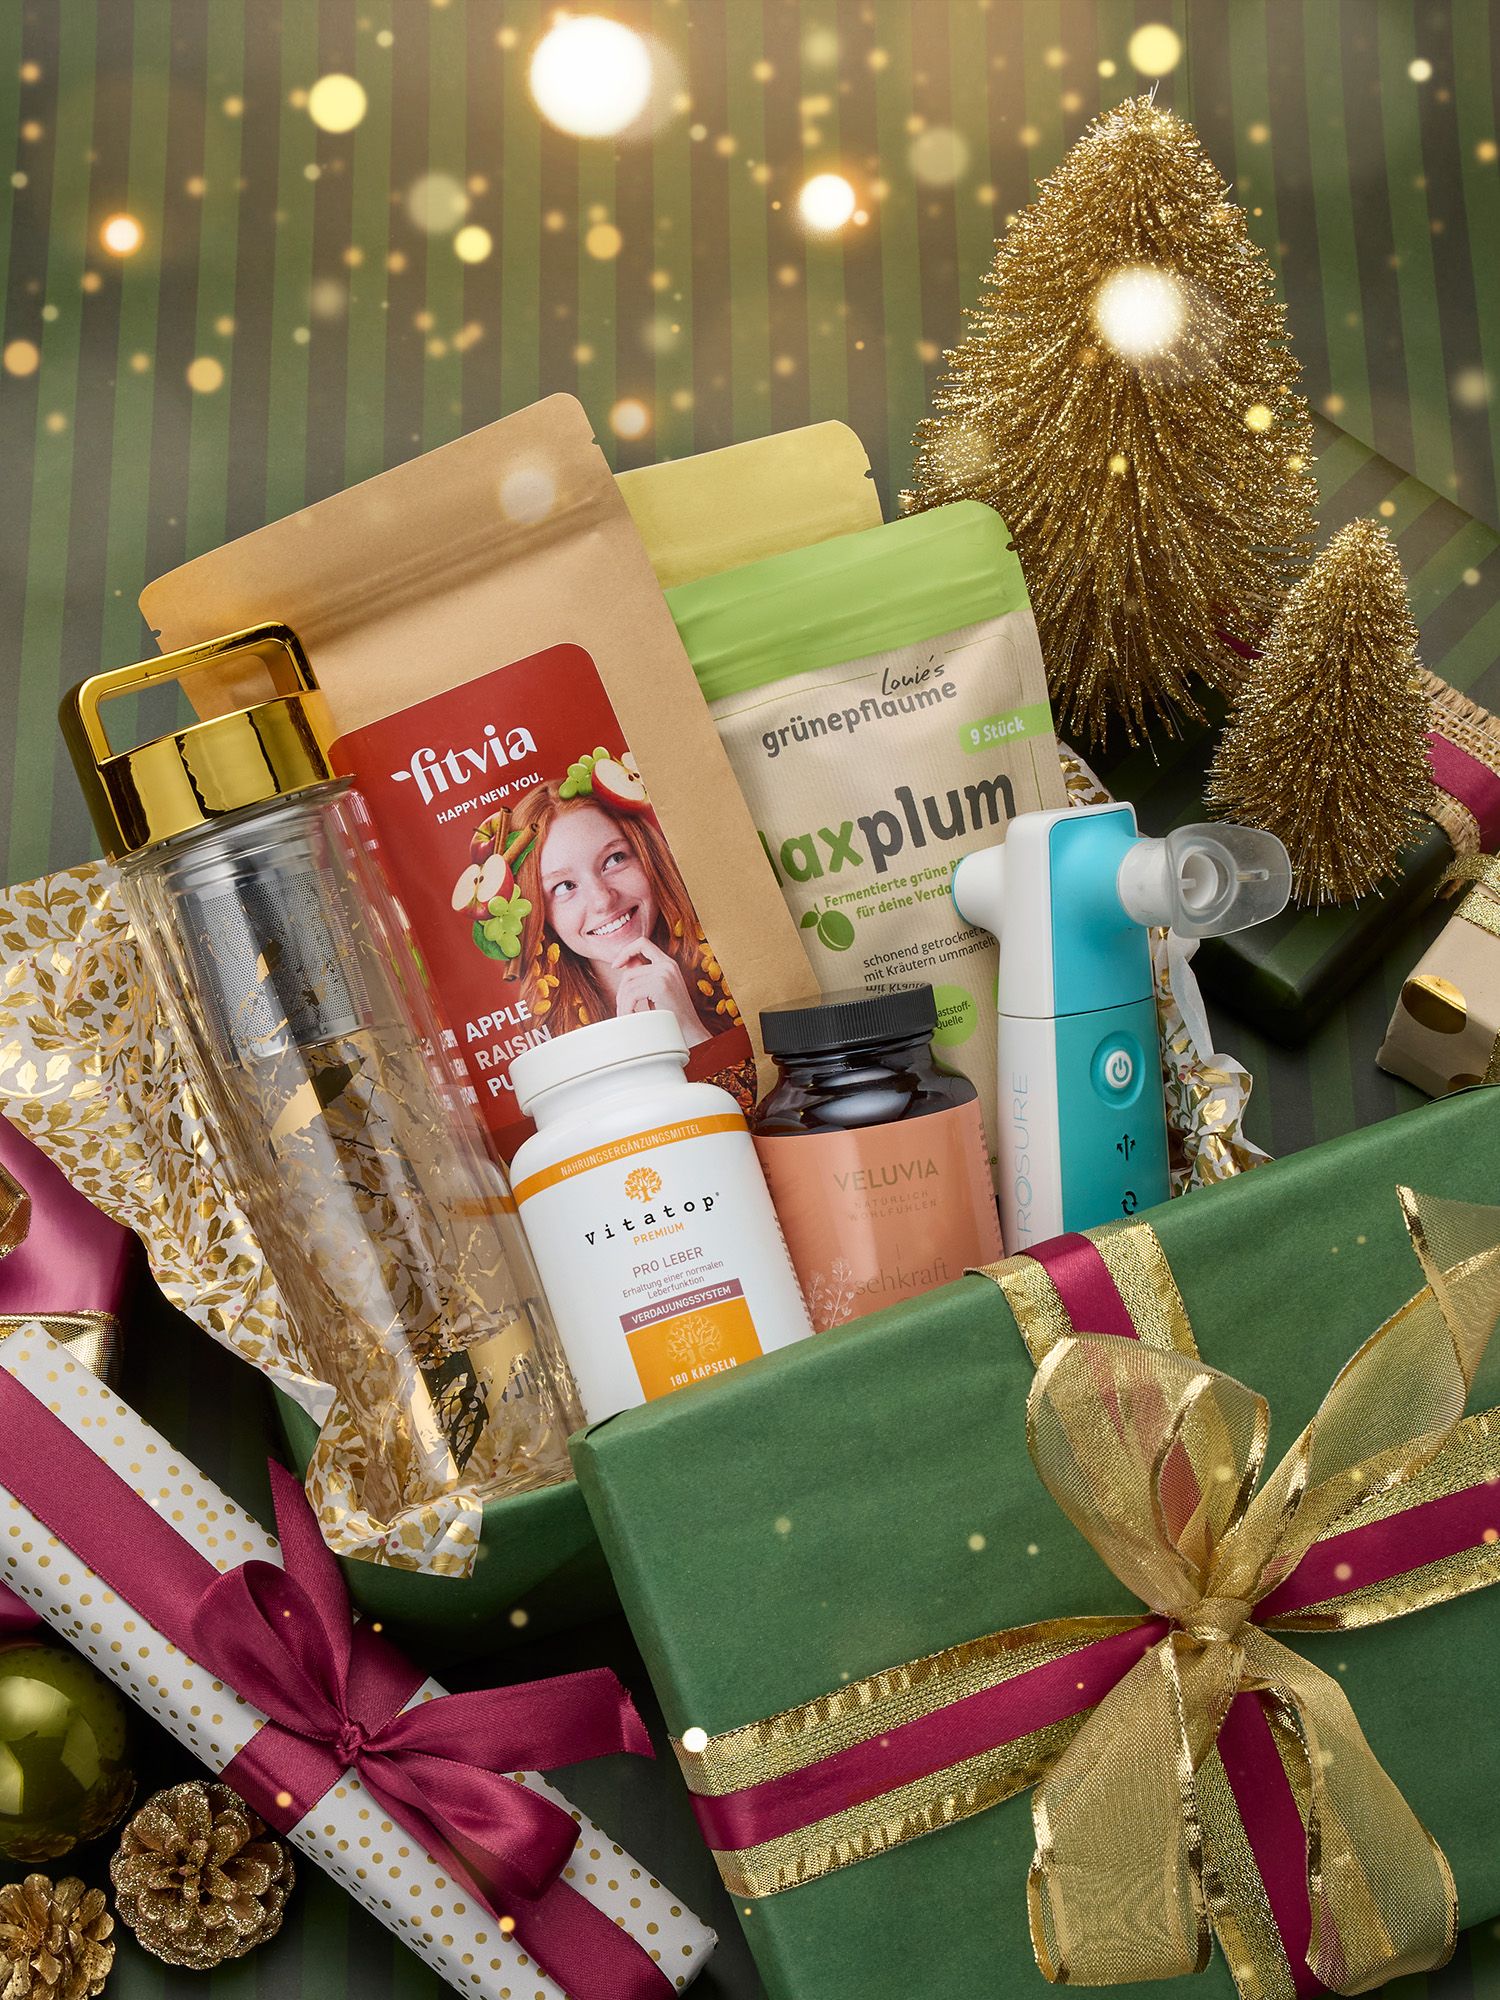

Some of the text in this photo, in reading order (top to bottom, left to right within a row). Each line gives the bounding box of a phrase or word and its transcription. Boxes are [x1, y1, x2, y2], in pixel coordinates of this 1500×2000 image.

[762, 681, 958, 758] grünepflaume
[969, 715, 1025, 745] 9 Stück
[392, 724, 538, 806] fitvia
[436, 772, 544, 824] HAPPY NEW YOU.
[823, 875, 908, 909] Fermentierte
[910, 863, 948, 887] grüne
[855, 884, 952, 920] für deine Verda
[863, 928, 979, 969] schonend getrocknet
[863, 936, 996, 983] mit Kräutern ummantelt
[465, 1000, 532, 1043] APPLE
[936, 1015, 964, 1031] Quelle
[937, 1001, 971, 1018] aststoff-
[474, 1024, 553, 1071] RAISIN
[486, 1074, 514, 1097] PU
[560, 1124, 702, 1177] NAHRUNGSERGÄNZUNGSMITTEL
[833, 1158, 940, 1193] VELUVIA
[632, 1222, 686, 1246] PREMIUM
[622, 1259, 725, 1298] Erhaltung einer normalen
[632, 1246, 705, 1279] PRO LEBER
[631, 1285, 732, 1325] VERDAUUNGSSYSTEM
[647, 1275, 705, 1300] Leberfunktion
[669, 1356, 738, 1388] 180 KAPSELN
